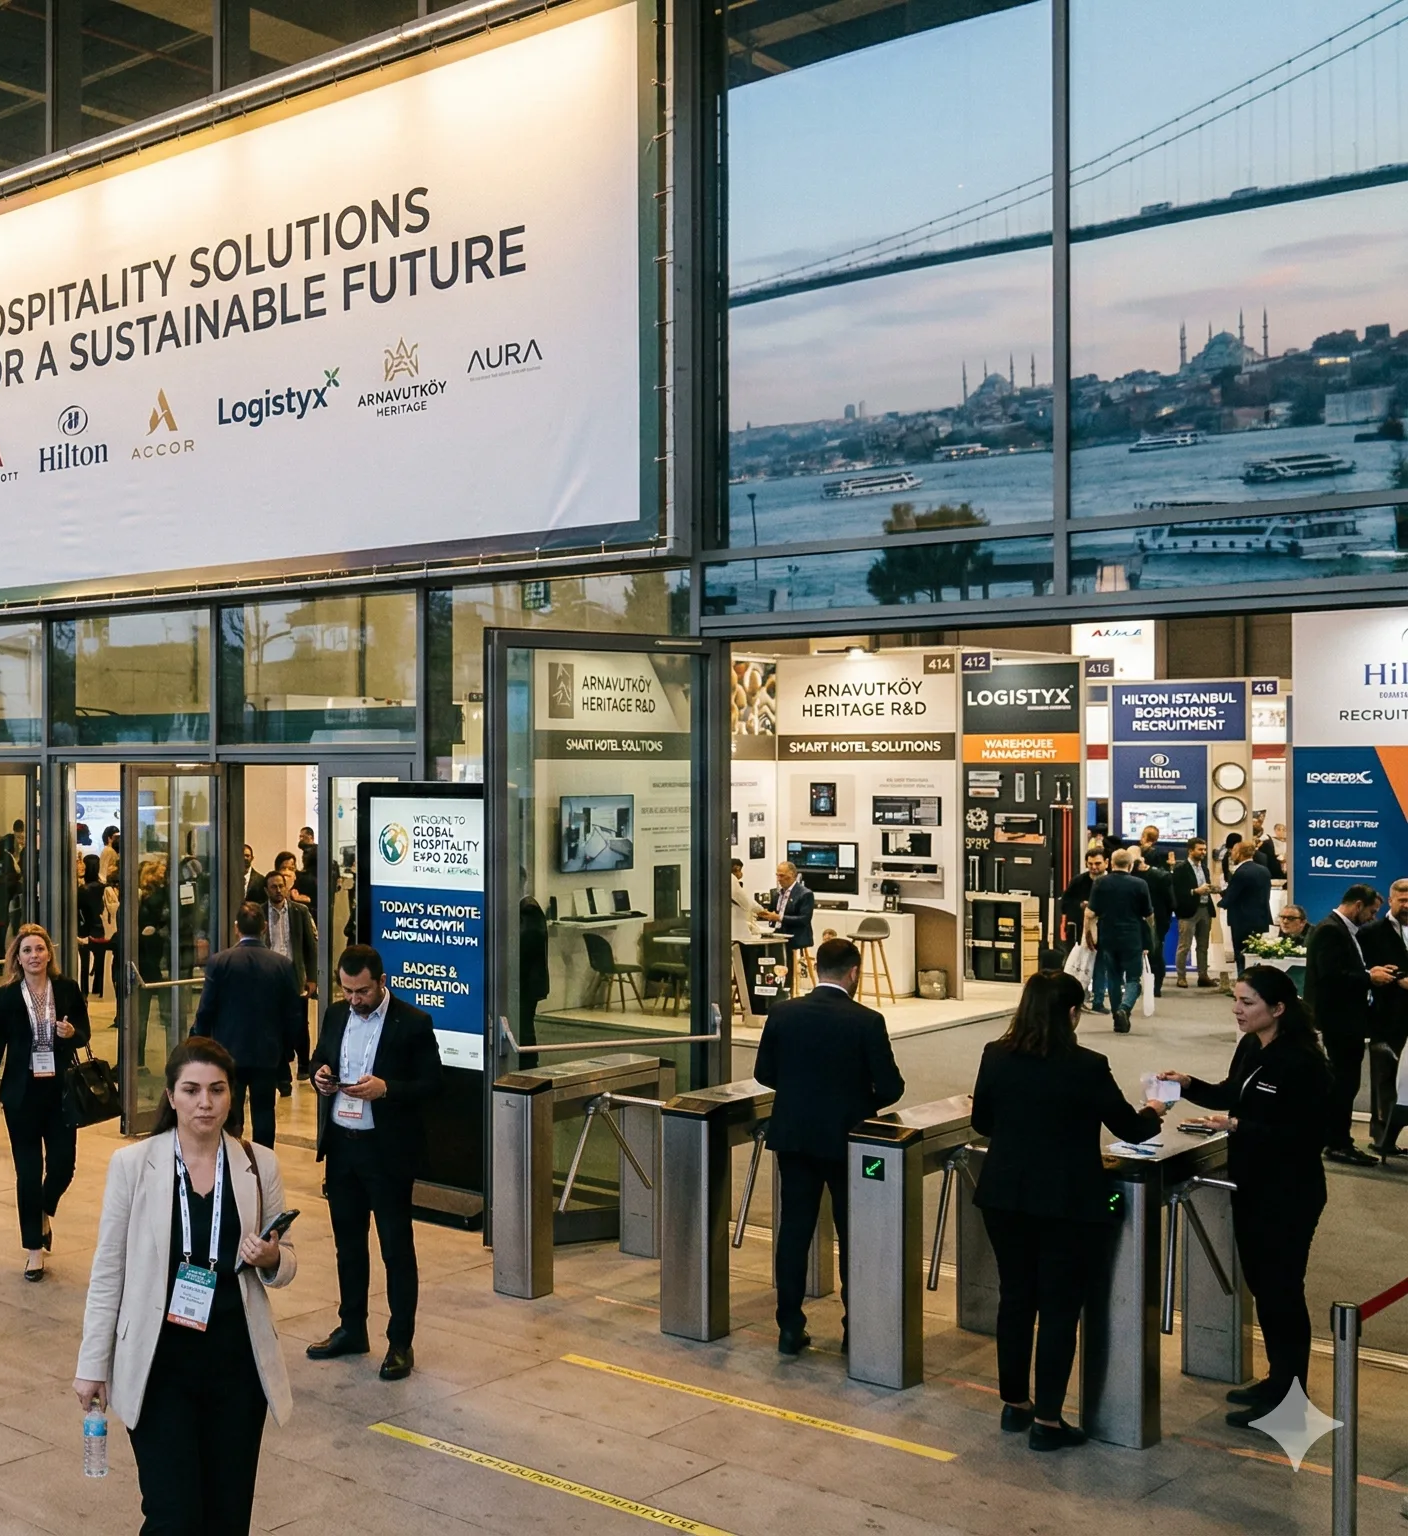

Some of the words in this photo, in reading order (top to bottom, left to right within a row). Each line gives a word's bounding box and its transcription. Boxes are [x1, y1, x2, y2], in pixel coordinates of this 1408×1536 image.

[190, 187, 430, 288] SOLUTIONS
[35, 340, 59, 380] A
[69, 273, 327, 371] SUSTAINABLE
[343, 225, 527, 312] FUTURE
[467, 339, 543, 373] AURA
[357, 379, 447, 408] ARNAVUTKÖY
[217, 386, 328, 428] Logistyx
[377, 401, 427, 417] HERITAGE
[131, 439, 195, 460] ACCOR
[38, 442, 109, 473] Hilton
[928, 659, 951, 669] 414
[964, 657, 986, 667] 412
[1088, 664, 1109, 673] 416
[804, 678, 923, 698] ARNAVUTKÖY
[1254, 684, 1274, 692] 416
[967, 688, 1070, 706] LOGISTYX
[1122, 694, 1169, 705] HILTON
[1172, 693, 1237, 704] ISTANBUL
[582, 697, 632, 712] HERITAGE
[635, 699, 656, 713] R&D
[802, 702, 885, 717] HERITAGE
[891, 702, 926, 716] R&D
[1135, 707, 1216, 718] BOSPHORUS
[1132, 720, 1225, 731] RECRUITMENT
[789, 741, 829, 753] SMART
[831, 741, 870, 752] HOTEL
[871, 740, 941, 752] SOLUTIONS
[1139, 767, 1180, 779] Hilton
[413, 826, 454, 838] GLOBAL
[413, 839, 479, 852] HOSPITALITY
[443, 852, 468, 864] 2026
[380, 900, 424, 914] TODAY'S
[395, 917, 419, 929] MICE
[403, 961, 446, 977] BADGES
[448, 966, 457, 978] &
[391, 976, 469, 995] REGISTRATION
[416, 993, 445, 1008] HERE
